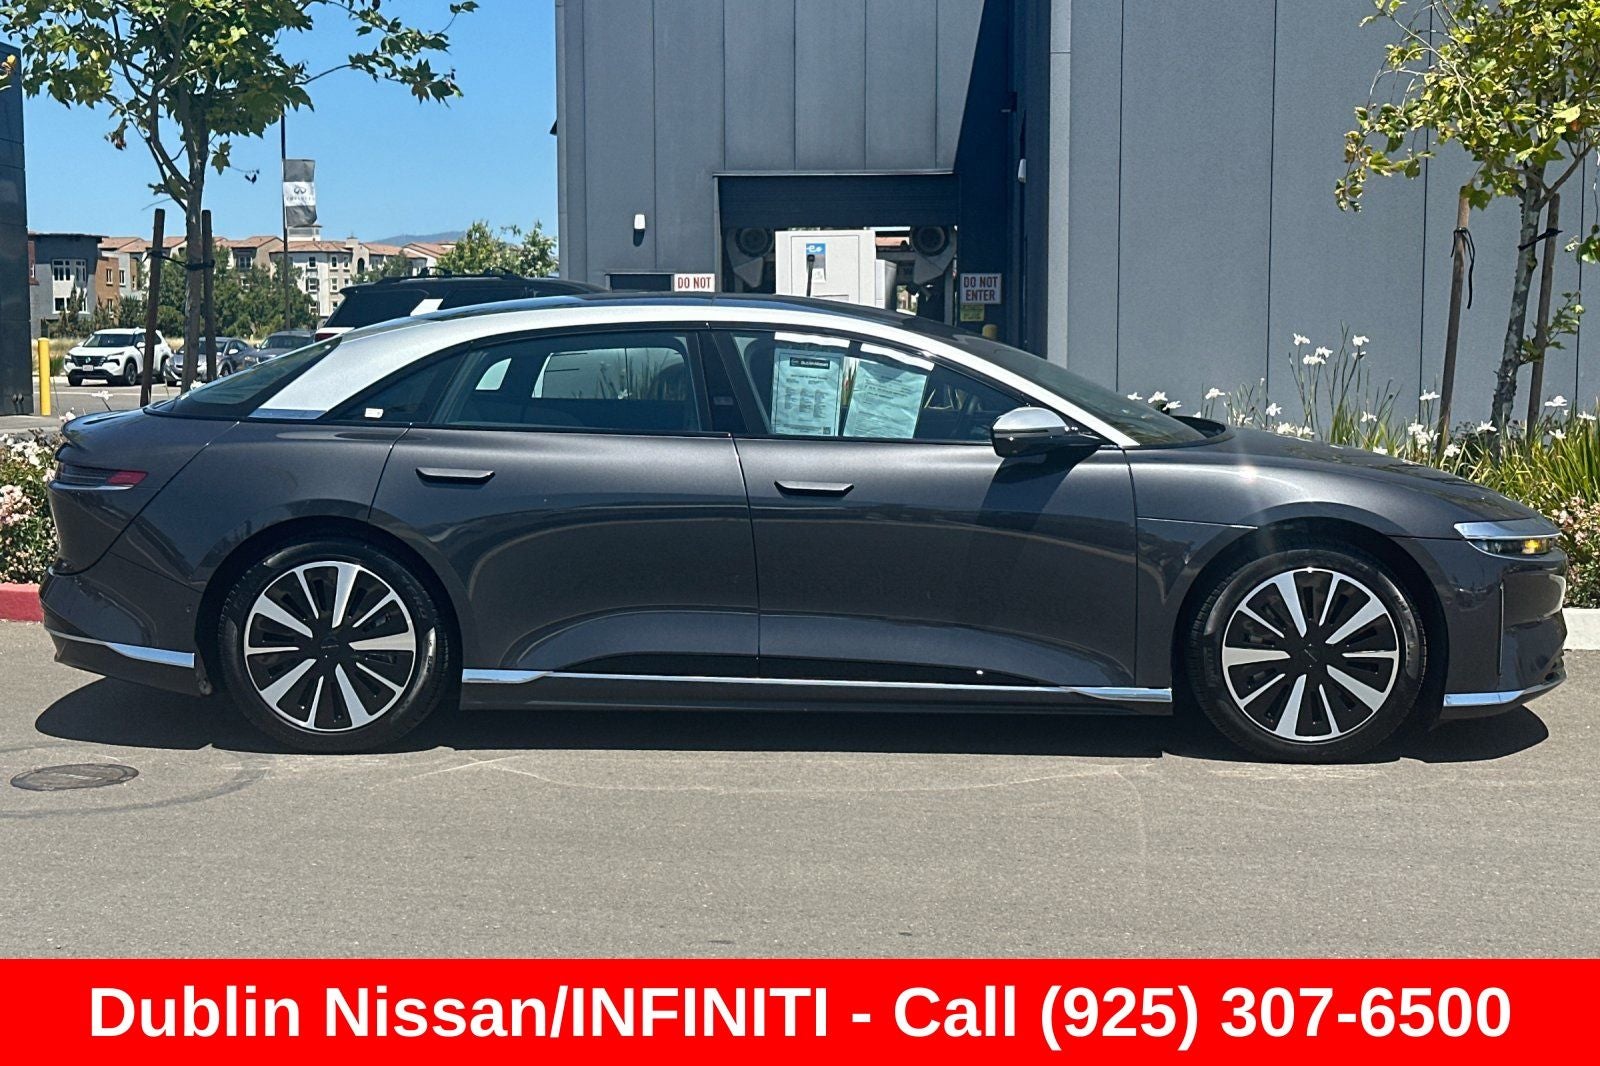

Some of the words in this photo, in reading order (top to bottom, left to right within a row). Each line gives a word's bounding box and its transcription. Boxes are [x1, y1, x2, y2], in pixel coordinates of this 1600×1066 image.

[677, 277, 690, 289] DO
[693, 277, 712, 289] NOT
[963, 276, 977, 288] DO
[979, 276, 998, 288] NOT
[965, 289, 996, 301] ENTER
